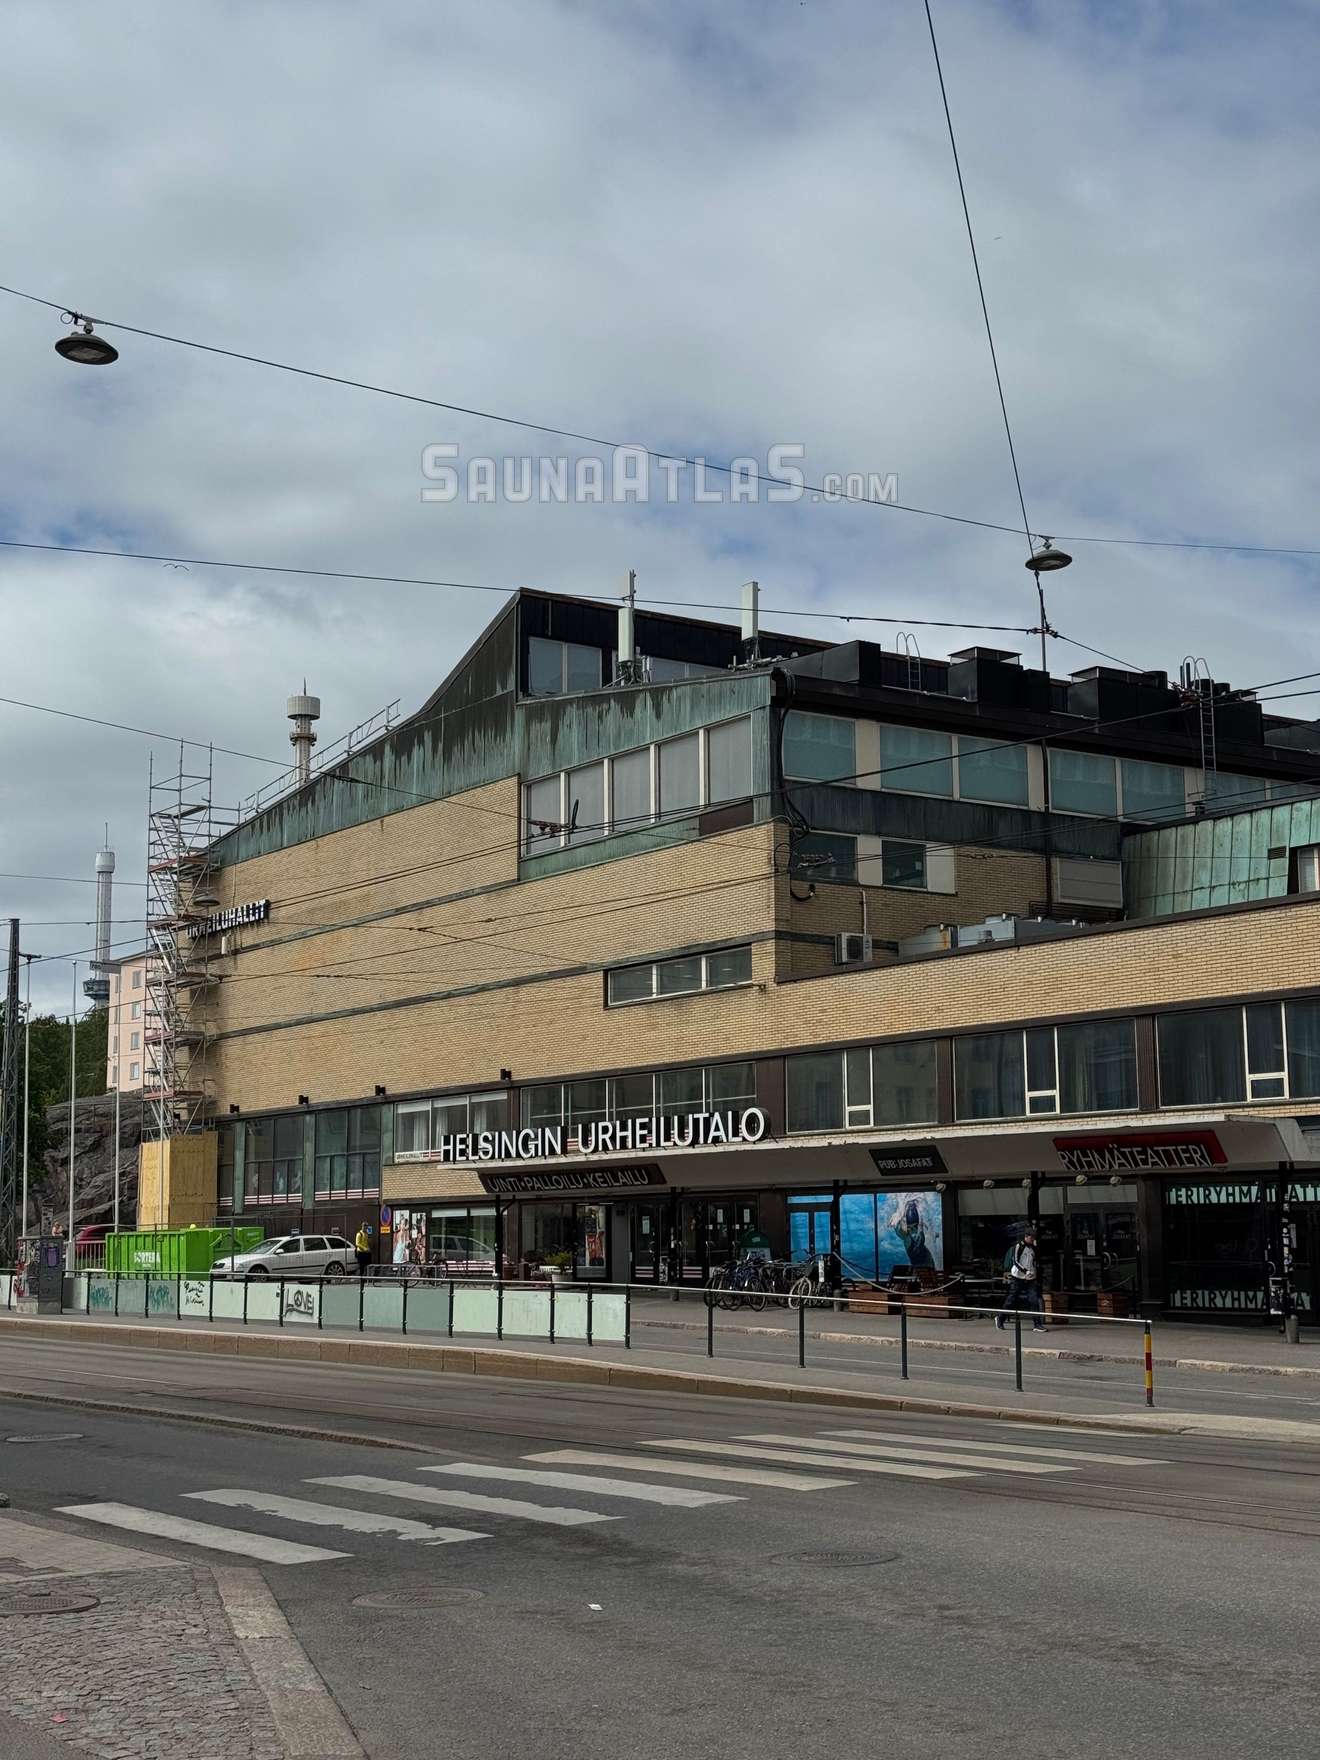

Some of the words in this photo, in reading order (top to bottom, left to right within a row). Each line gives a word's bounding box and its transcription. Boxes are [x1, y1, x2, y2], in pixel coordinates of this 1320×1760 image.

[440, 1126, 561, 1162] HELSINGIN
[577, 1107, 764, 1153] URHEILUTALO
[1057, 1143, 1213, 1171] RYHMÄTEATTERI
